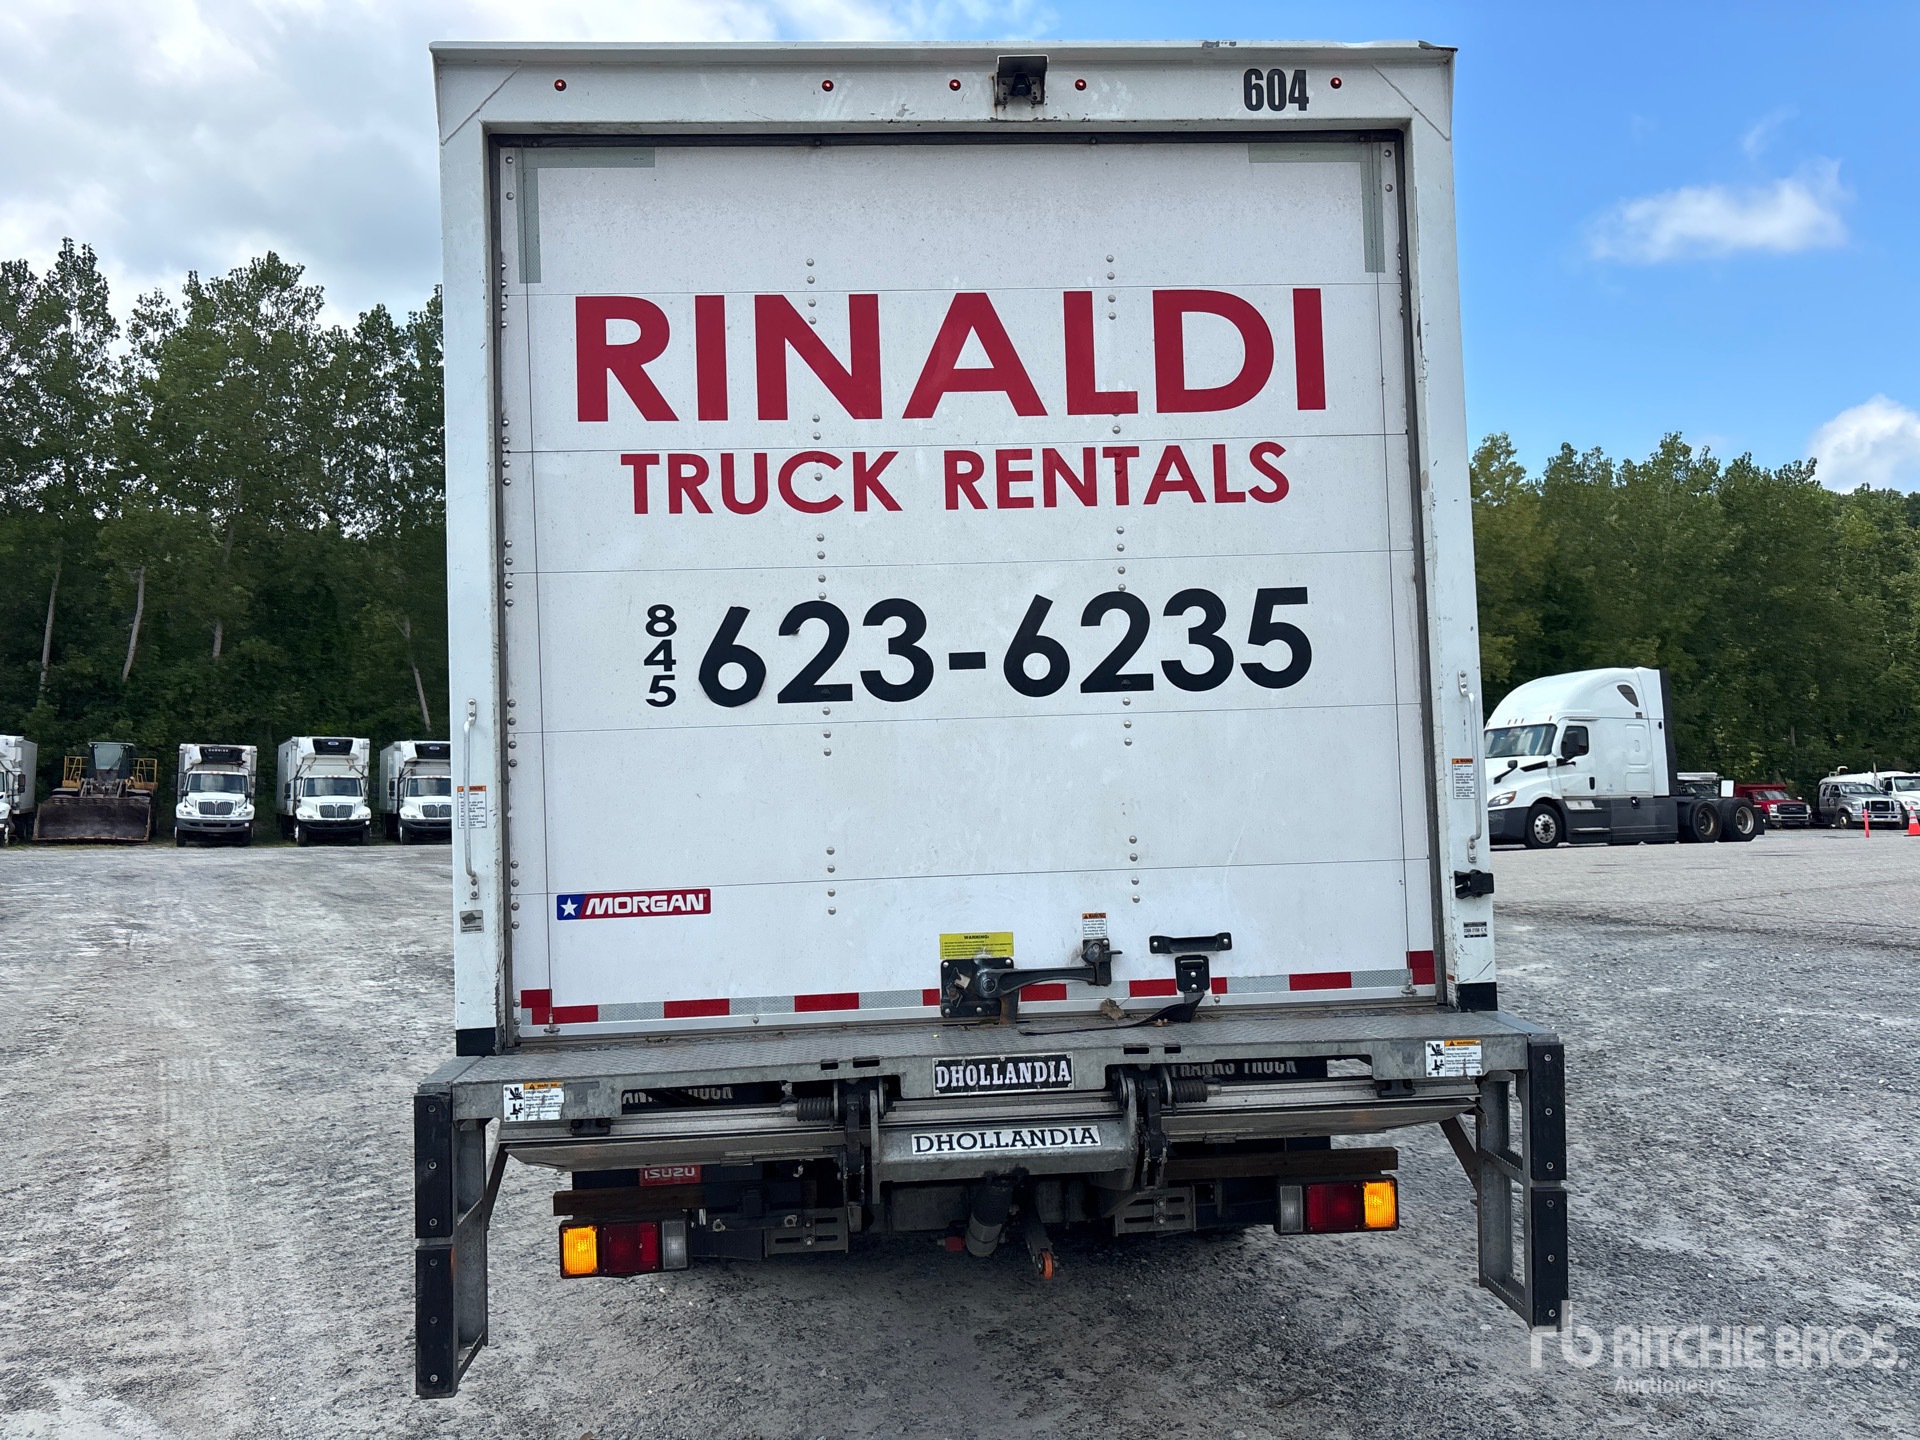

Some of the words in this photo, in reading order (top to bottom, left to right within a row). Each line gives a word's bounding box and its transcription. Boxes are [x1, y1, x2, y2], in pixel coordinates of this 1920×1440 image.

[1243, 69, 1309, 111] 604
[575, 287, 1326, 422] RINALDI
[620, 450, 903, 515] TRUCK
[943, 441, 1290, 510] RENTALS
[643, 603, 677, 708] 845
[698, 586, 1312, 707] 623-6235
[585, 893, 705, 915] MORGAN
[936, 1060, 1071, 1088] DHOLLANDIA
[913, 1127, 1098, 1153] DHOLLANDIA
[644, 1167, 695, 1179] ISUZU
